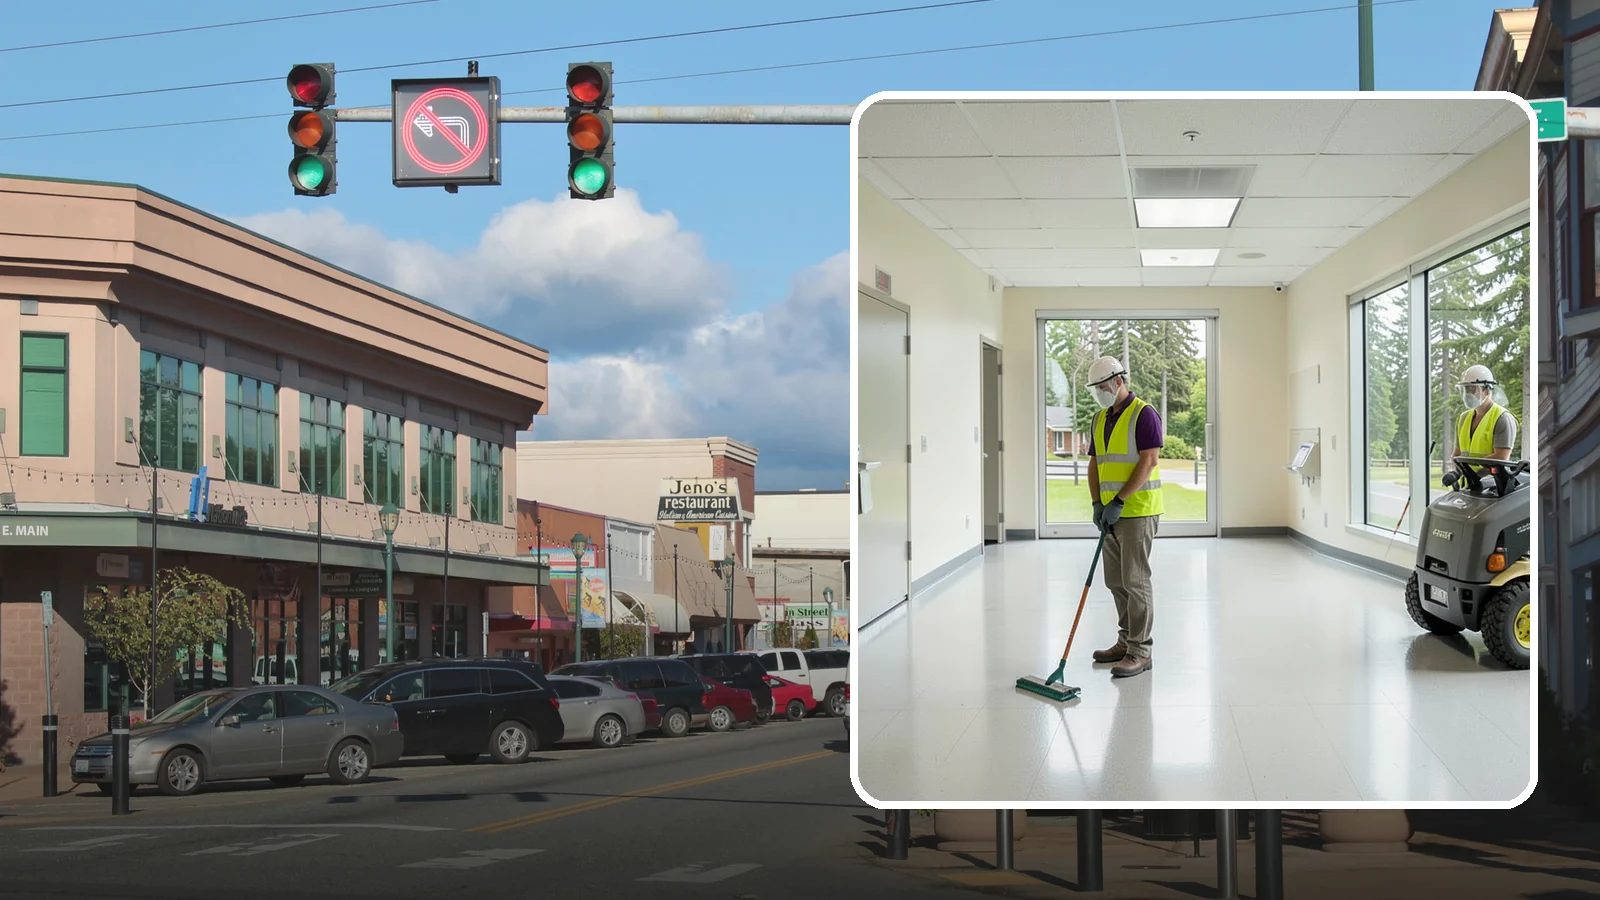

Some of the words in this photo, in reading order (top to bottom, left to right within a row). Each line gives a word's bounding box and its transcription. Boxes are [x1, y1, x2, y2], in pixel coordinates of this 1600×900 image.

[670, 480, 728, 495] Jeno's
[665, 497, 731, 509] restaurant
[686, 509, 715, 519] American
[715, 509, 738, 519] Cuisine
[2, 525, 13, 536] E.
[15, 525, 49, 536] MAIN
[797, 607, 829, 616] Street
[791, 619, 824, 627] lass
